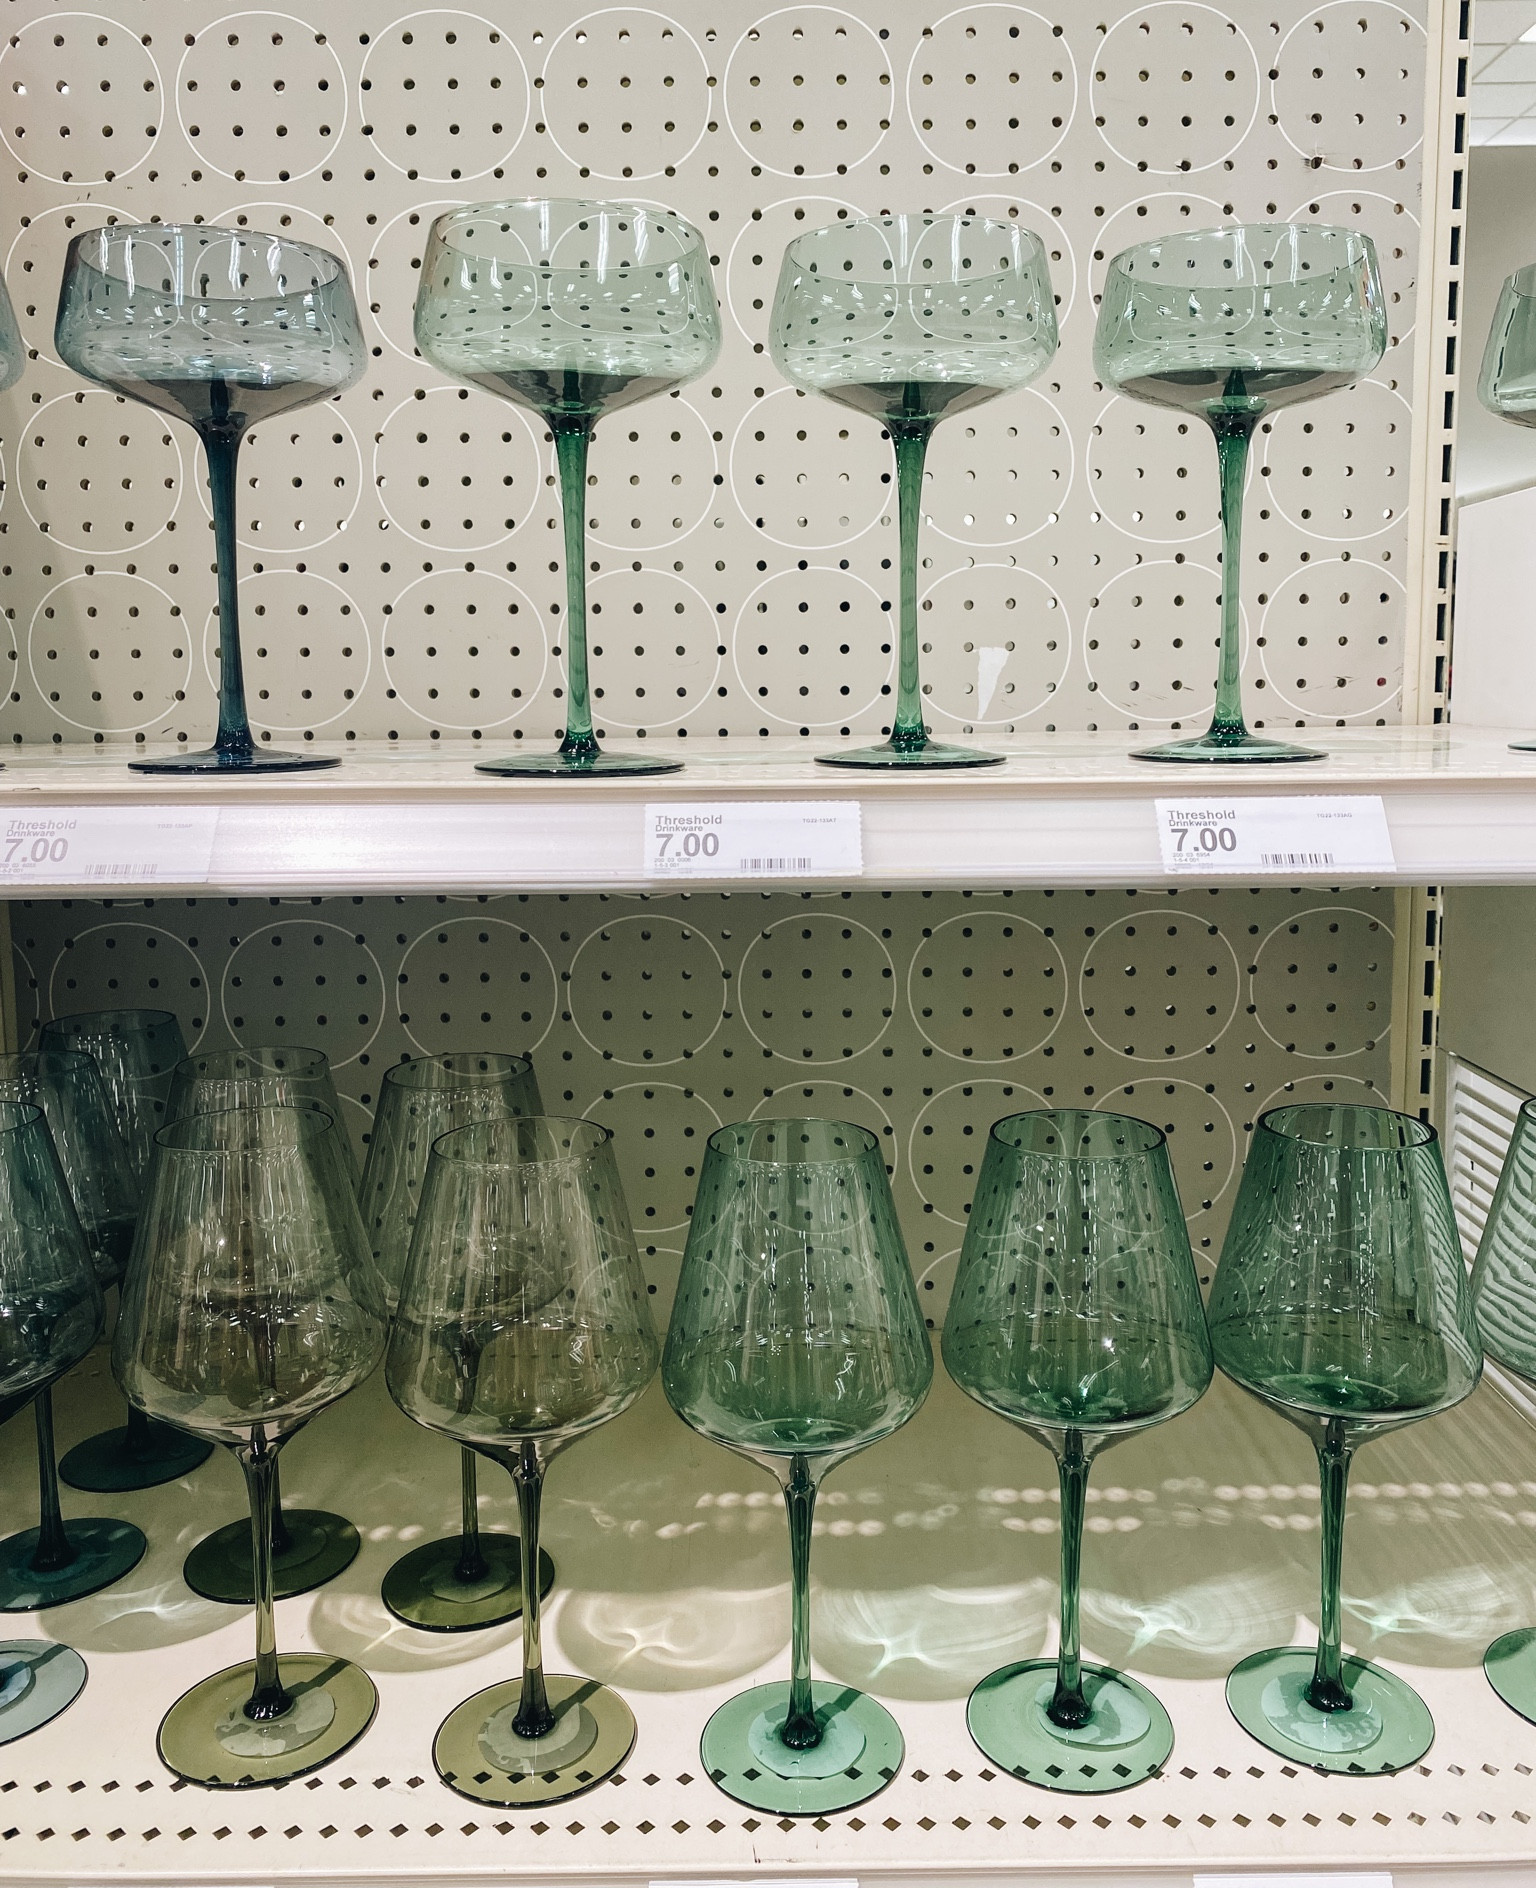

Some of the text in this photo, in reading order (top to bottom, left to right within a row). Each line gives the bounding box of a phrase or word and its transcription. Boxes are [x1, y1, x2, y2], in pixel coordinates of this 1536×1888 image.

[655, 815, 722, 825] Threshold
[1168, 810, 1236, 820] Threshold
[9, 820, 77, 830] Threshold
[655, 824, 704, 832] Drinkware
[1168, 819, 1218, 827] Drinkware
[6, 829, 56, 837] Drinkware
[655, 832, 720, 857] 7.00
[1170, 827, 1237, 852] 7.00
[4, 838, 69, 863] 7.00
